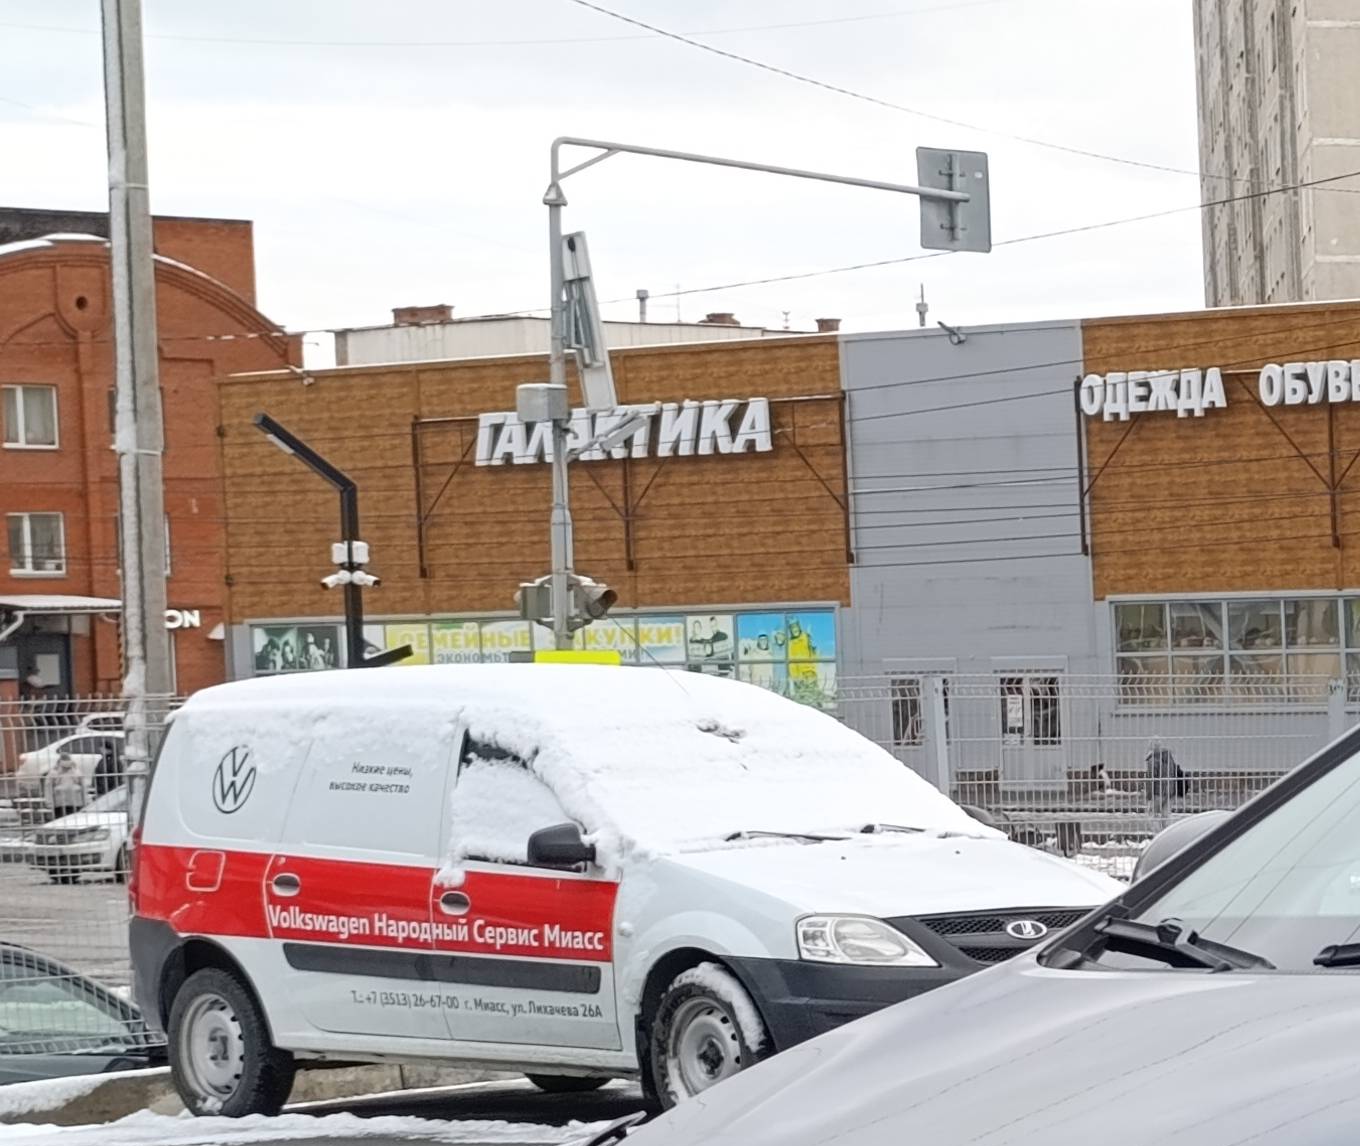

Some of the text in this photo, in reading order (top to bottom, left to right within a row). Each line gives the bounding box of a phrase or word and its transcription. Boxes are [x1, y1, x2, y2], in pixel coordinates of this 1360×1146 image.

[1080, 367, 1227, 422] ОДЕЖДА
[269, 905, 604, 950] Volkswagen Народный Сервис Миасс
[412, 993, 459, 1009] 26-67-00
[473, 998, 509, 1015] Миасс,
